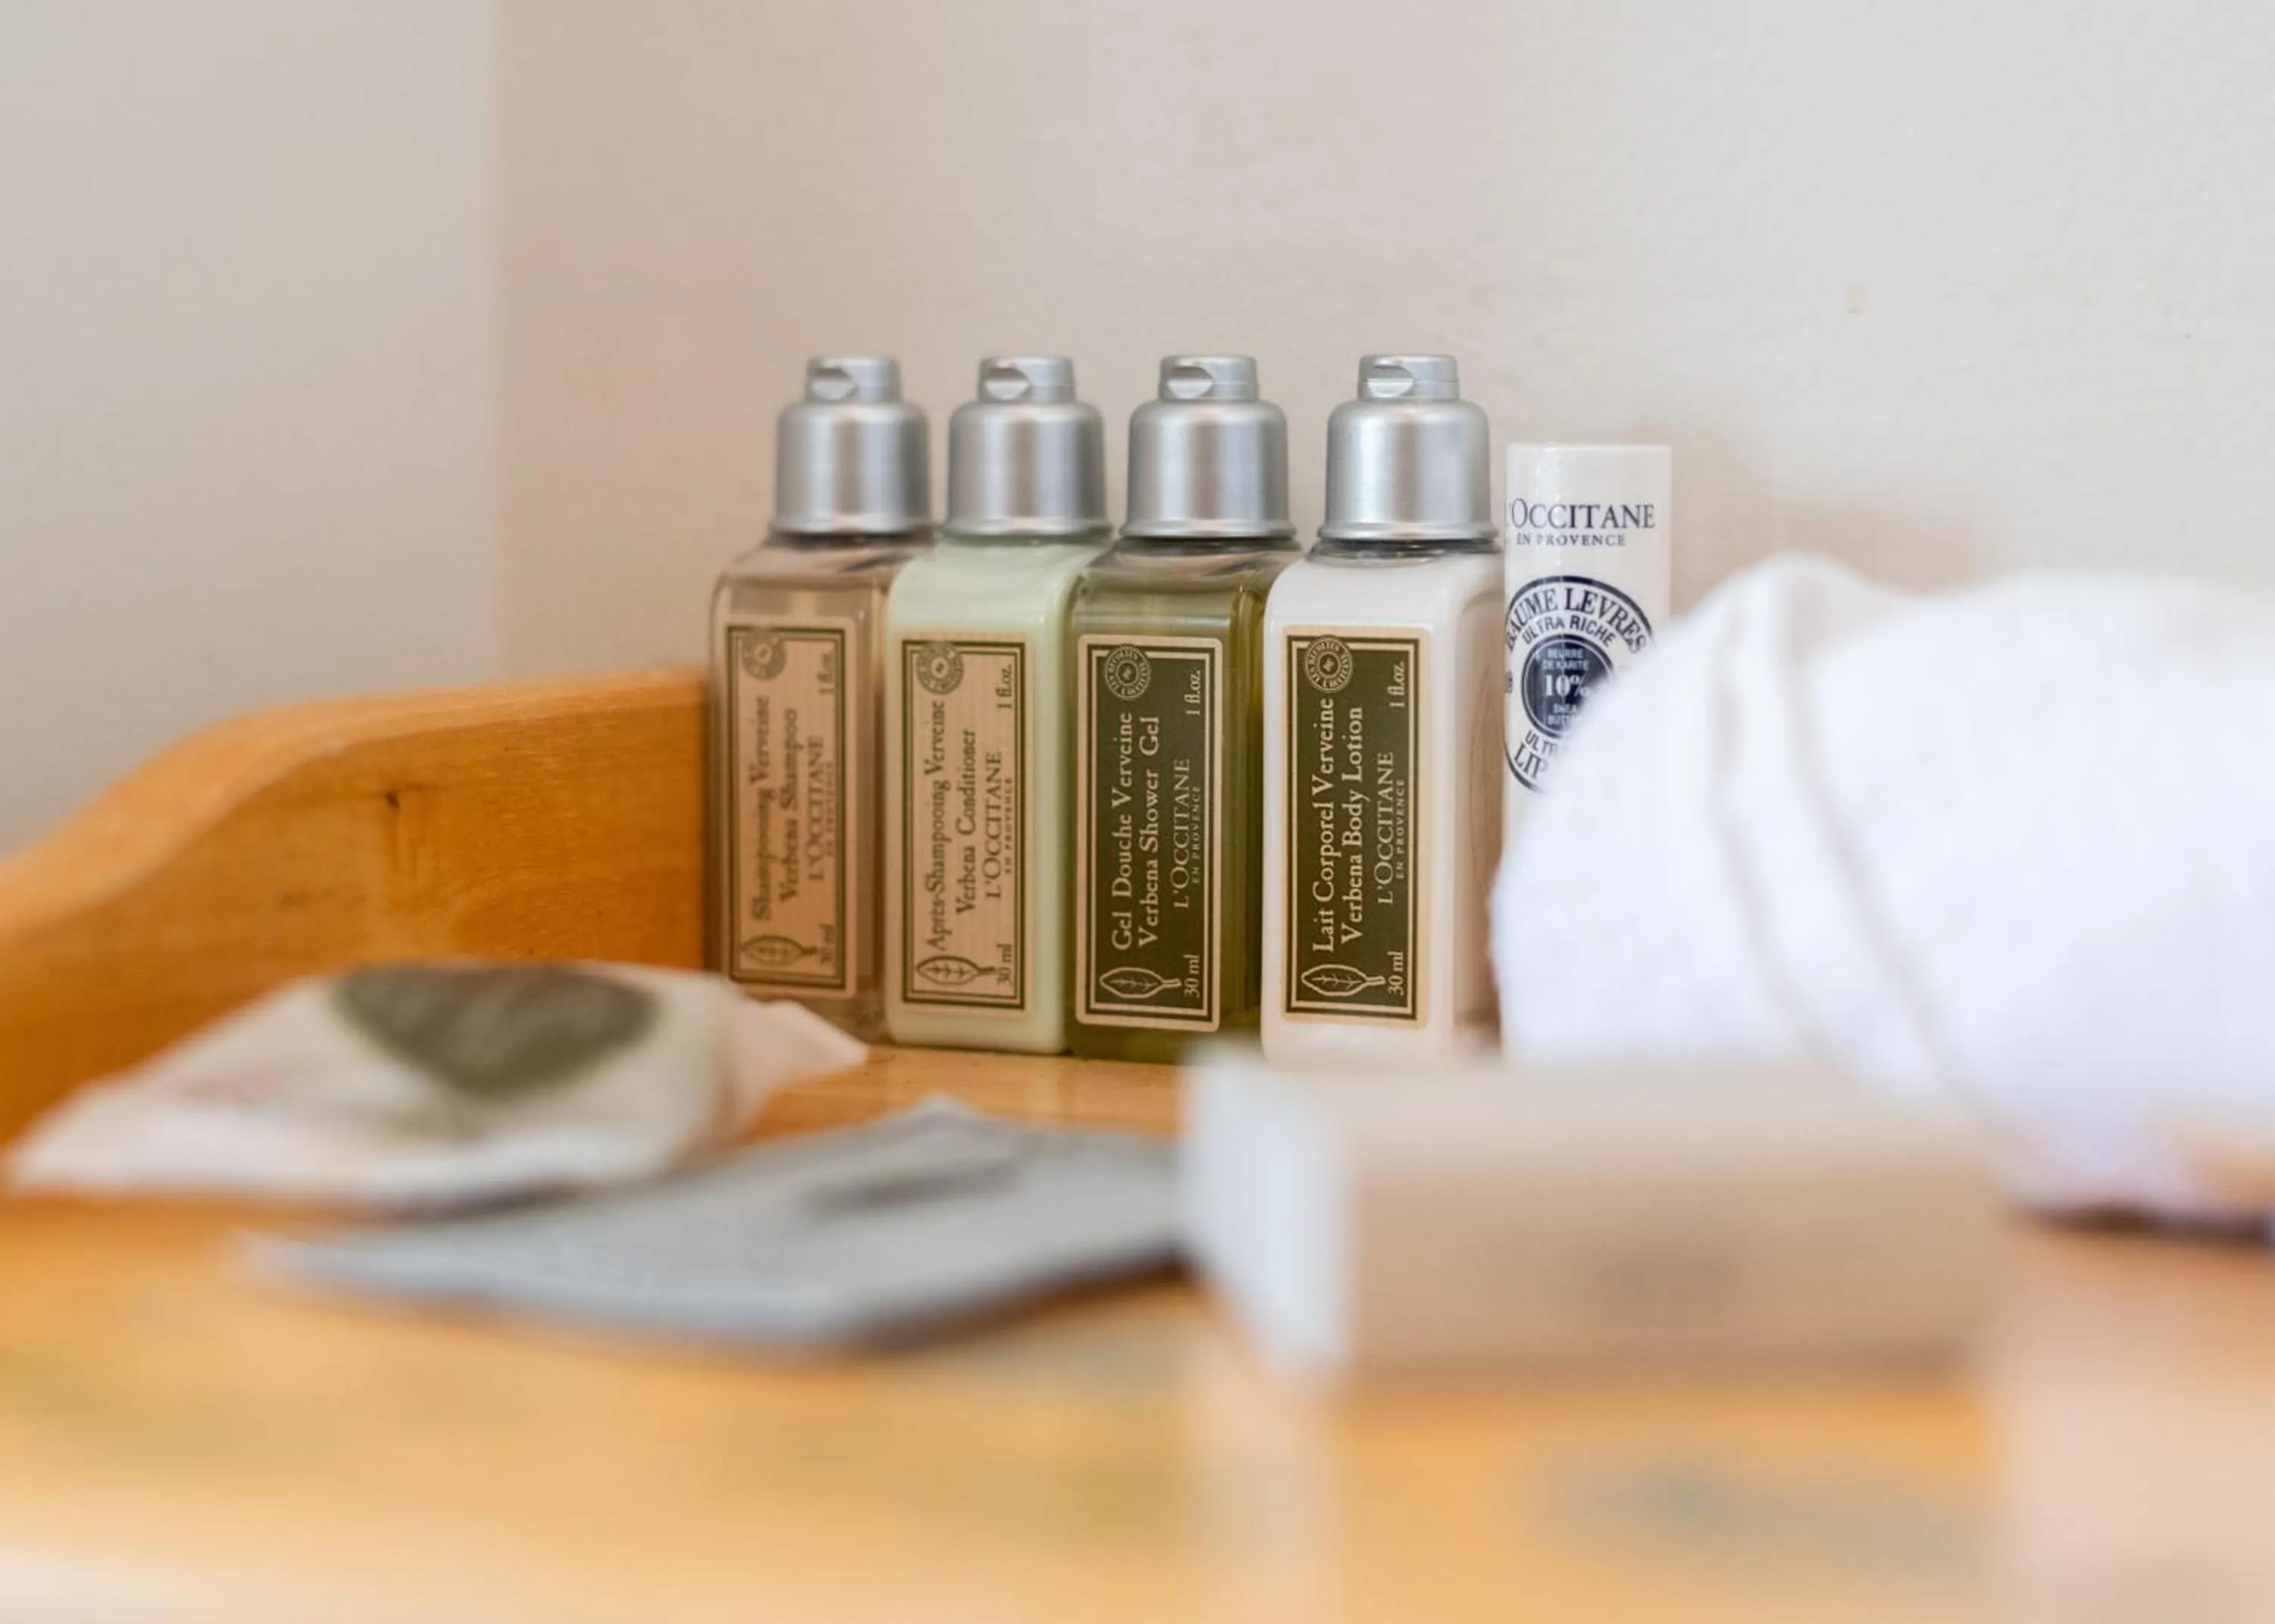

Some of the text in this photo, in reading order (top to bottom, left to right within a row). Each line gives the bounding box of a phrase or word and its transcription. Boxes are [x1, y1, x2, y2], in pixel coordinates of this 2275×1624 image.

[1504, 498, 1656, 529] 'OCCITANE
[1517, 532, 1626, 547] EN PROVENCE
[1570, 615, 1615, 647] RICHE
[778, 707, 803, 812] Shampoo
[924, 701, 946, 776] Verveine
[805, 735, 825, 882] L'OCCITANE
[956, 729, 977, 915] Verbena Conditioner
[983, 751, 1002, 898] L'OCCITANE
[1111, 712, 1134, 951] Gel Douche Verveine
[1139, 715, 1160, 947] Verbena Shower Gel
[1171, 758, 1191, 908] L'OCCITANE
[1192, 785, 1200, 884] EN PROVENCE
[1312, 698, 1341, 953] Lait Corporel Verveine
[1341, 707, 1370, 944] Verbena Body Lotion
[1373, 752, 1394, 904] L'OCCITANE
[1395, 779, 1405, 879] EN PROVENCE
[997, 943, 1013, 986] 30 ml
[1184, 955, 1200, 999] 30 ml
[1387, 951, 1404, 995] 30 ml
